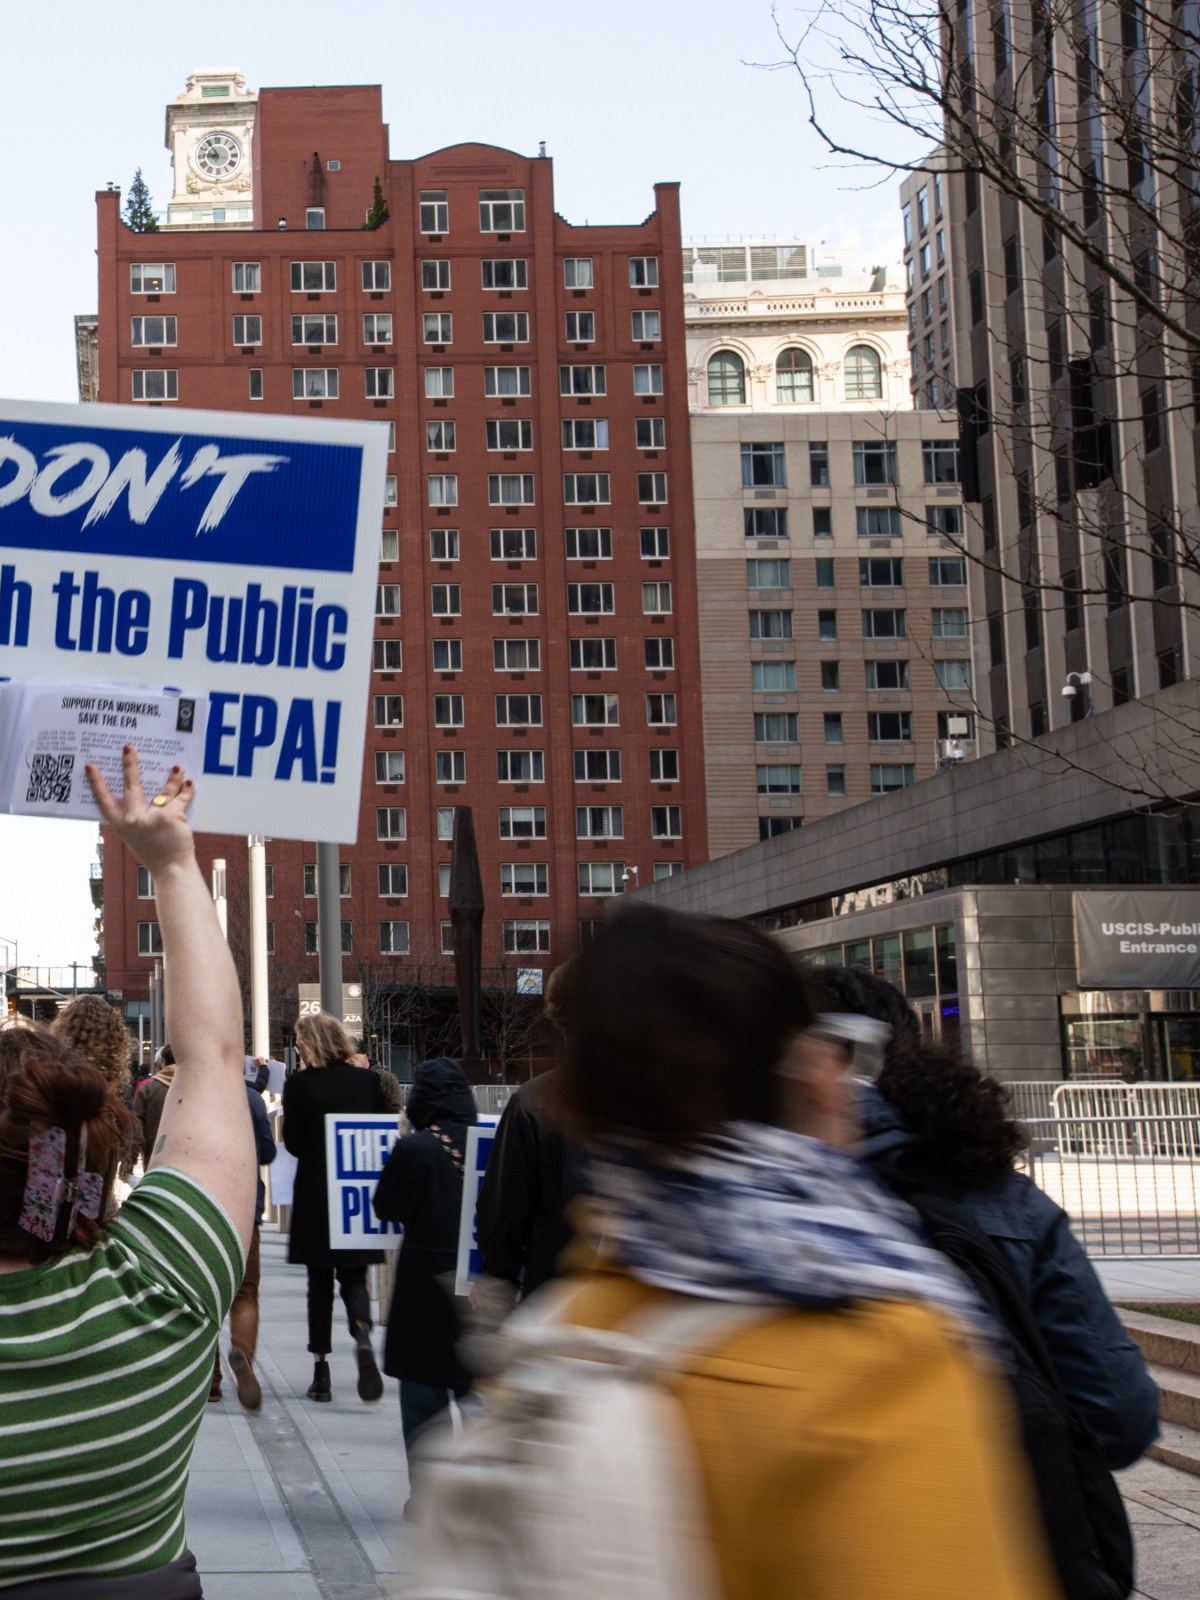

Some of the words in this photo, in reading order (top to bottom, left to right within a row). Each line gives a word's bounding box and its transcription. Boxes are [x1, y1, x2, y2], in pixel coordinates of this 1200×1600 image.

[52, 571, 150, 656] the
[167, 577, 348, 672] Public
[62, 697, 96, 710] SUPPORT
[97, 698, 114, 712] EPA
[116, 700, 161, 718] WORKERS,
[78, 711, 99, 725] SAVE
[102, 713, 119, 727] THE
[120, 715, 137, 730] EPA
[203, 691, 342, 785] EPA!
[1101, 922, 1200, 936] USCIS-Publi
[1119, 940, 1198, 954] Entrance
[300, 1001, 320, 1014] 26
[338, 1128, 401, 1172] THE
